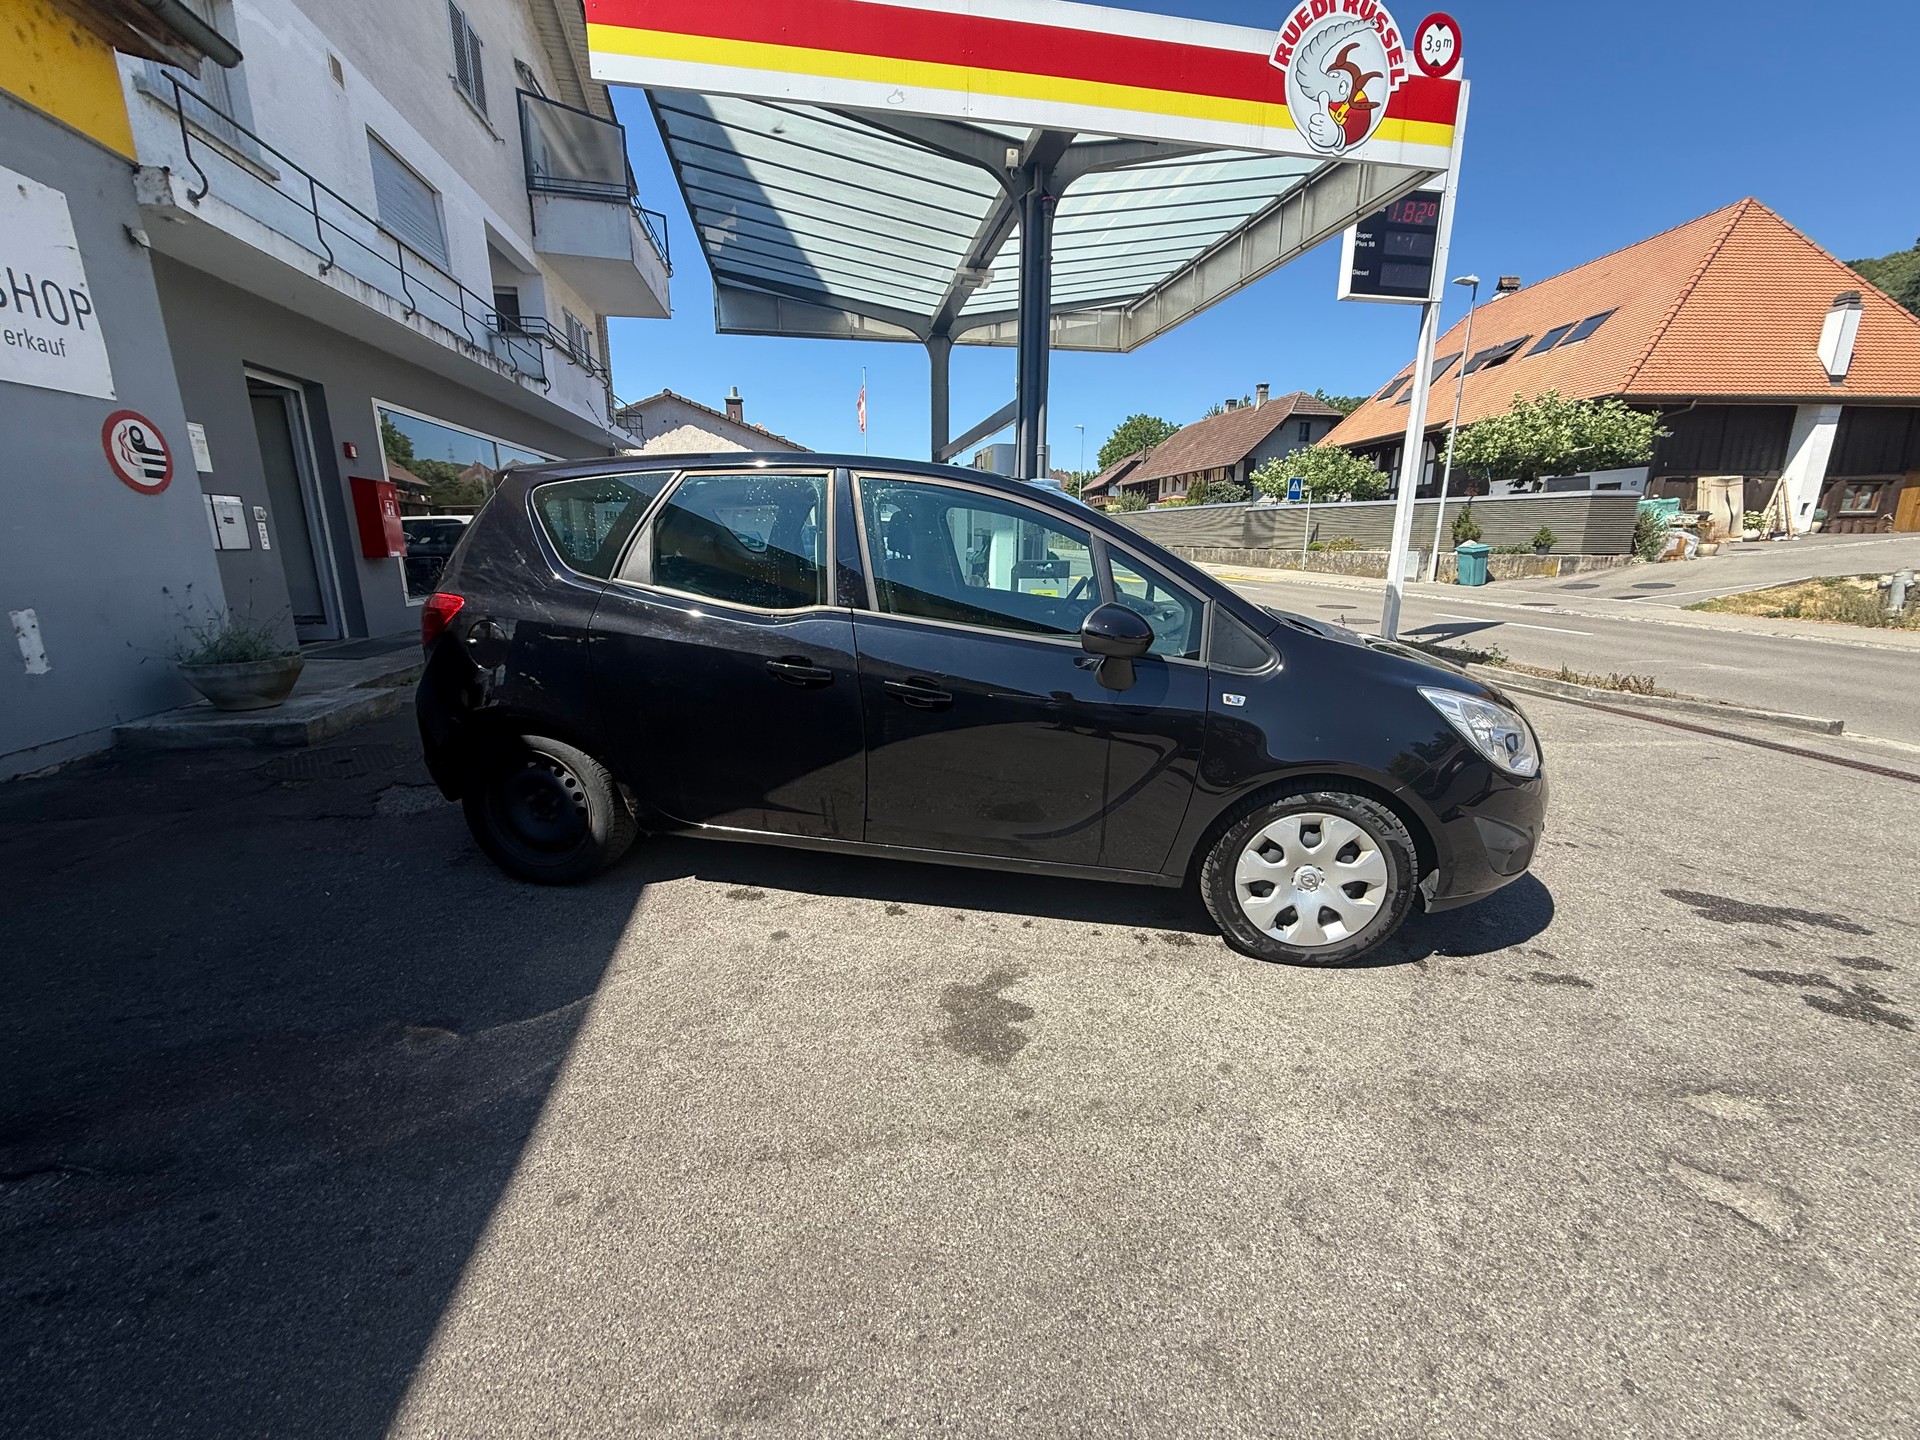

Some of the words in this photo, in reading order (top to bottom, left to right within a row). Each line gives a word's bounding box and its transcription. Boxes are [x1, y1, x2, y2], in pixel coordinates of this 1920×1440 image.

[1273, 0, 1337, 67] RUEDI
[1356, 231, 1373, 240] Super
[1352, 268, 1370, 276] Diesel
